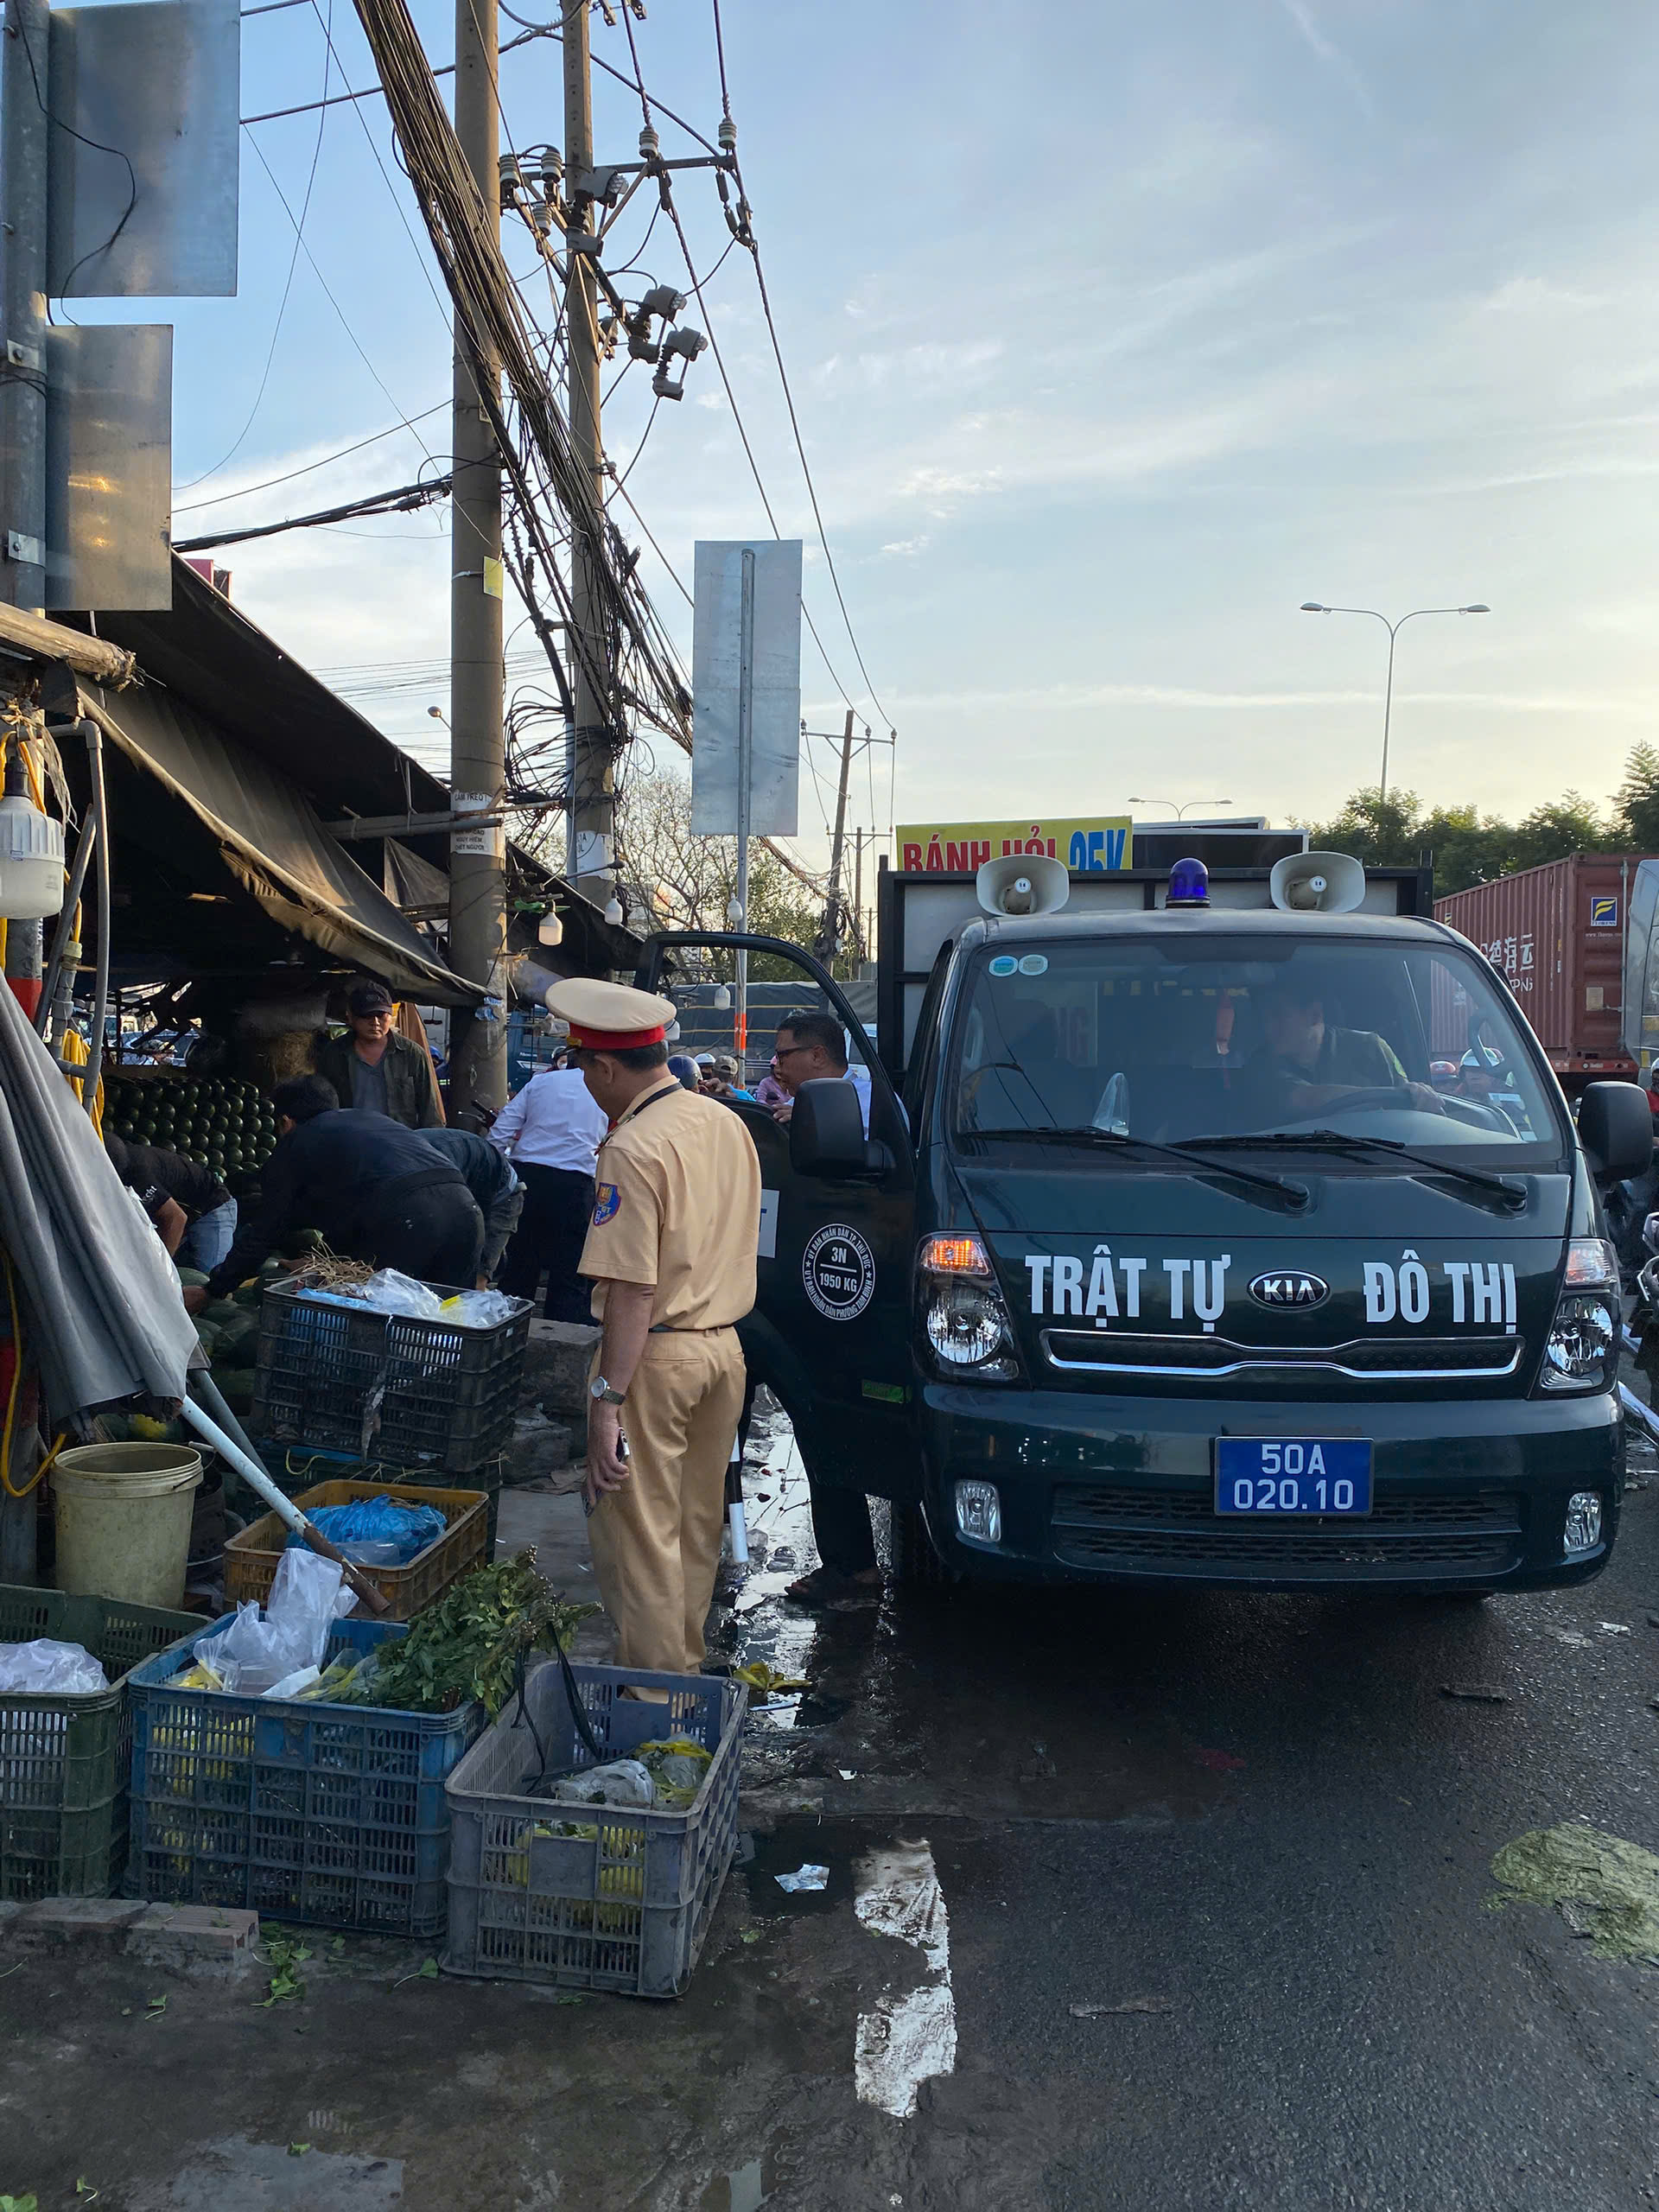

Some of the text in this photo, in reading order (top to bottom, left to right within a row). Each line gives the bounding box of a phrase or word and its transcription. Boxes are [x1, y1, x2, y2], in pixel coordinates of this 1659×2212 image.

[903, 834, 991, 871] BÁNH
[1070, 829, 1126, 871] 25K
[831, 1247, 847, 1264] 3N
[819, 1272, 857, 1293] 1950 KG
[1025, 1244, 1517, 1334] TRẬT TỰ ĐÔ THỊ
[1262, 1279, 1317, 1300] KIA
[1262, 1444, 1326, 1474] 50A
[1234, 1478, 1354, 1510] 020.10
